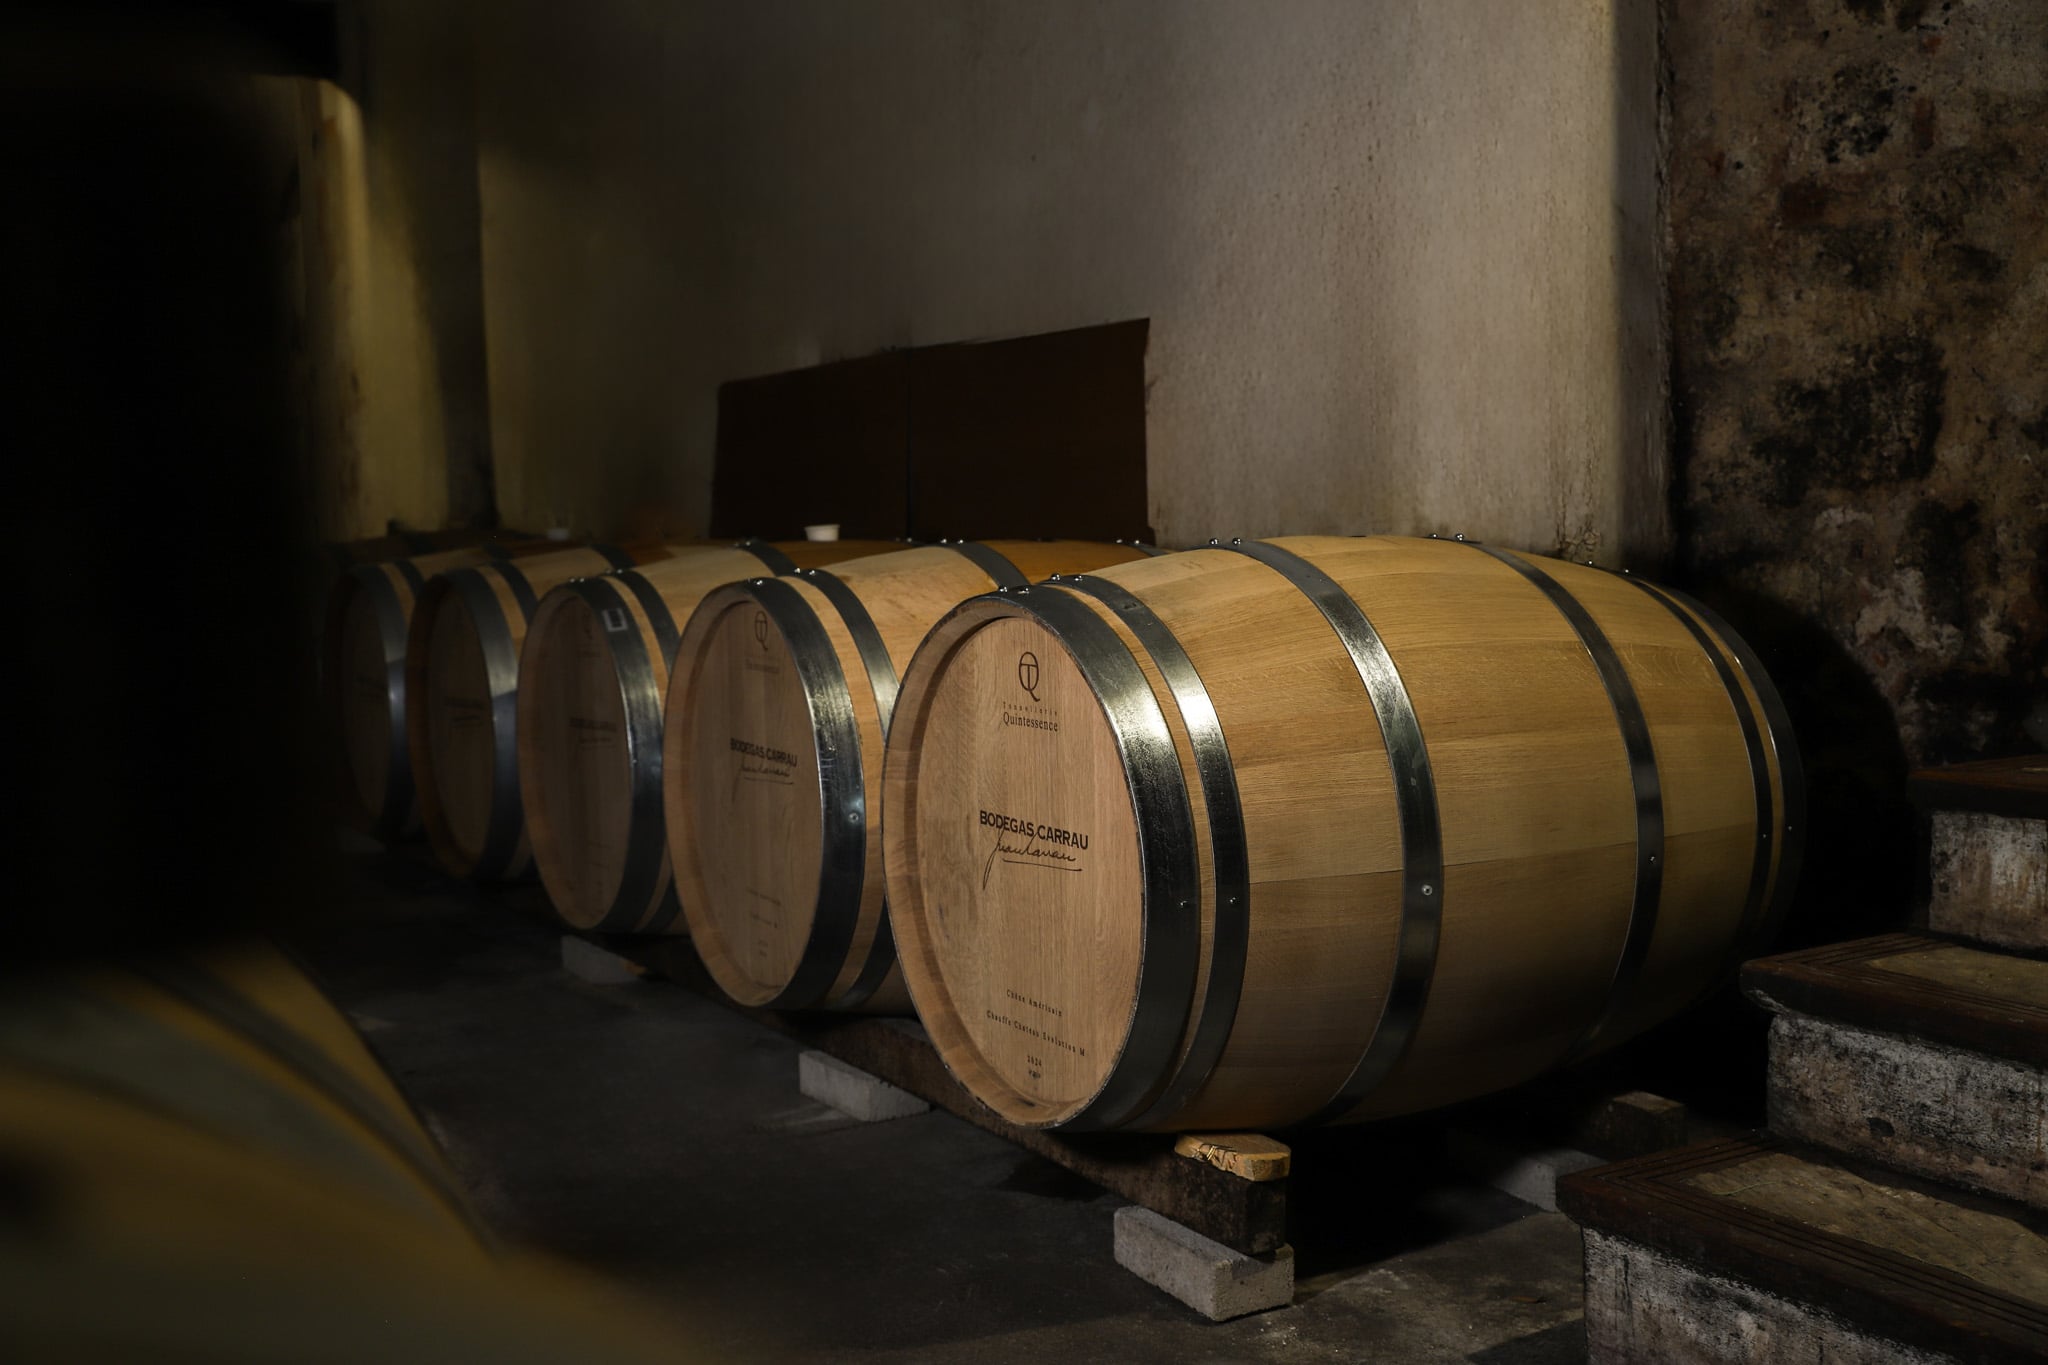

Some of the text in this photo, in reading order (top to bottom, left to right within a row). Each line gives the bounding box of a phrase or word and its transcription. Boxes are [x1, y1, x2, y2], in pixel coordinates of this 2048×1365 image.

[1003, 711, 1058, 732] Quintessence
[730, 737, 798, 768] BODEGAS CARRAU
[980, 810, 1089, 850] BODEGAS CARRAU
